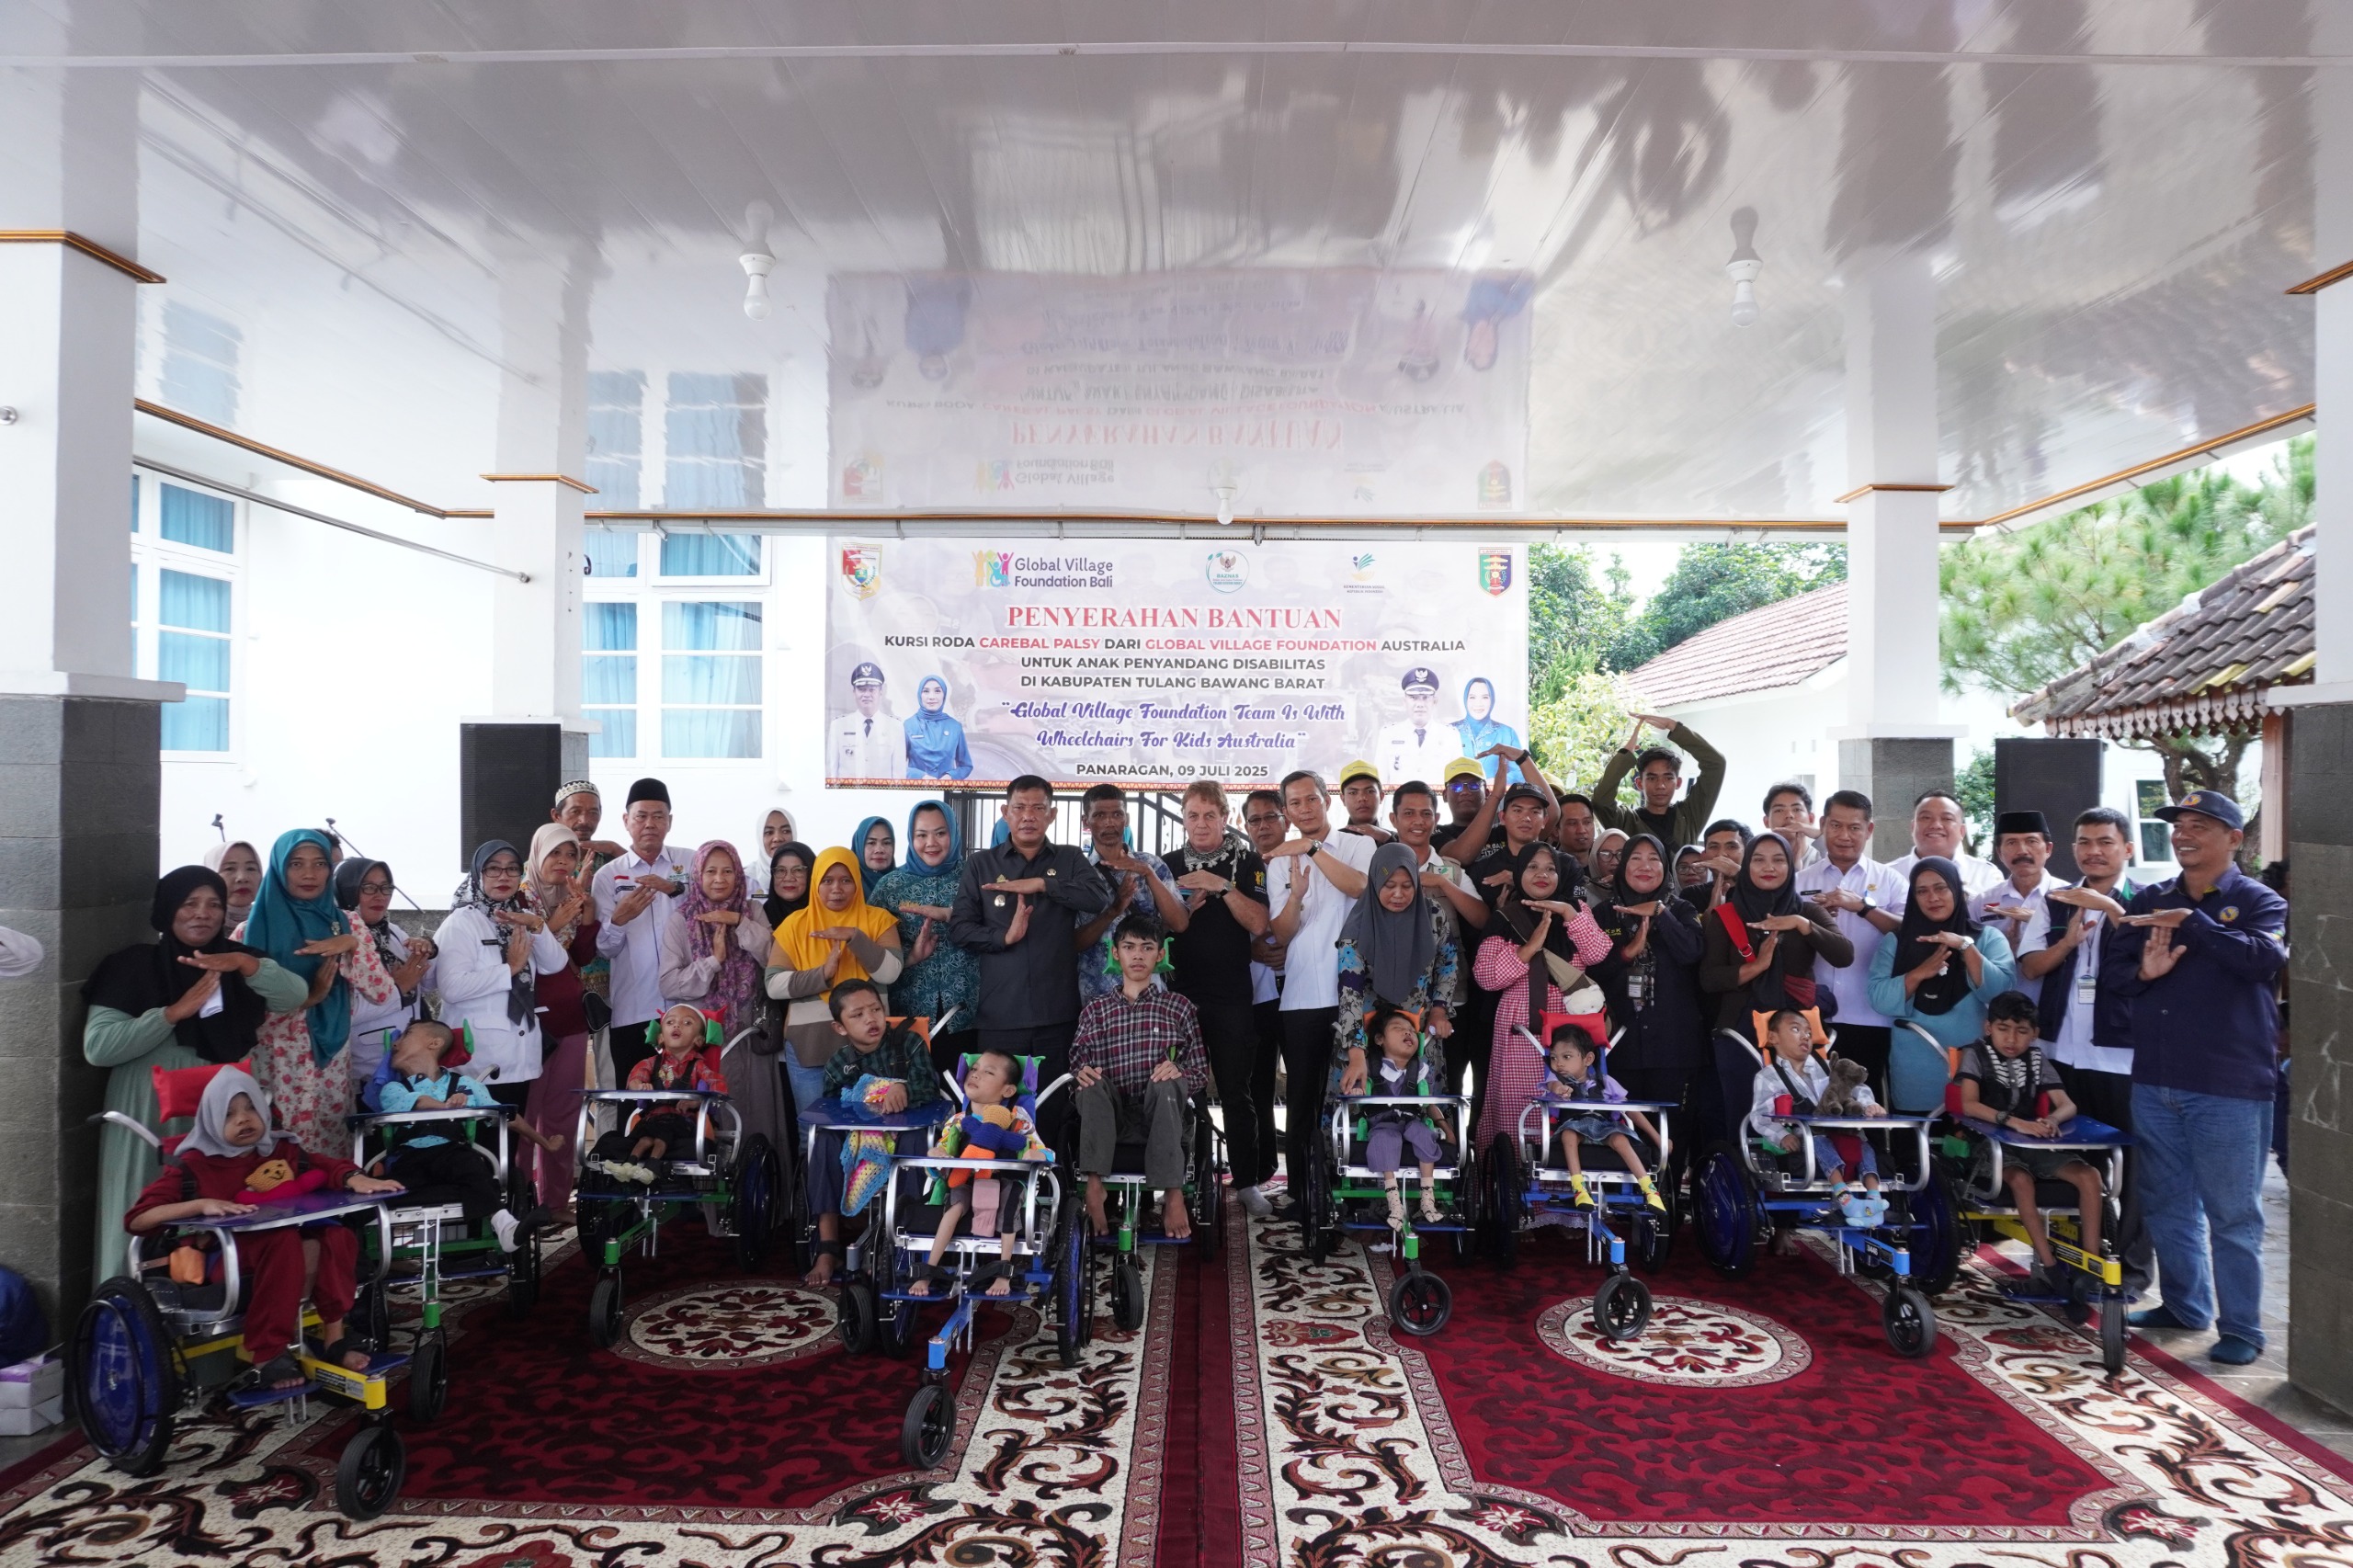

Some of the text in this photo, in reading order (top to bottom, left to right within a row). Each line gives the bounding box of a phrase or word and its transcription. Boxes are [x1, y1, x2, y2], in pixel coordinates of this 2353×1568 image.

[1015, 558, 1113, 575] Global Village
[1015, 575, 1113, 587] Foundation Bali
[1008, 607, 1342, 629] PENYERAHAN BANTUAN
[884, 636, 1465, 652] KURSI RODA CAREBAL PALSY DARI GLOBAL VILLAGE FOUNDATION AUSTRALIA
[1021, 657, 1325, 670] UNTUK ANAK PENYANDANG DISABILITAS
[1021, 676, 1325, 689] DI KABUPATEN TULANG BAWANG BARAT
[1071, 700, 1133, 724] Village
[1140, 702, 1227, 720] Foundation
[1233, 704, 1275, 721] Team
[1281, 704, 1298, 721] Is
[1303, 704, 1345, 721] With
[1037, 731, 1133, 747] Wheelchairs
[1140, 731, 1168, 748] For
[1173, 732, 1211, 748] Kids
[1076, 765, 1268, 778] PANARAGAN, 09 JULI 2025
